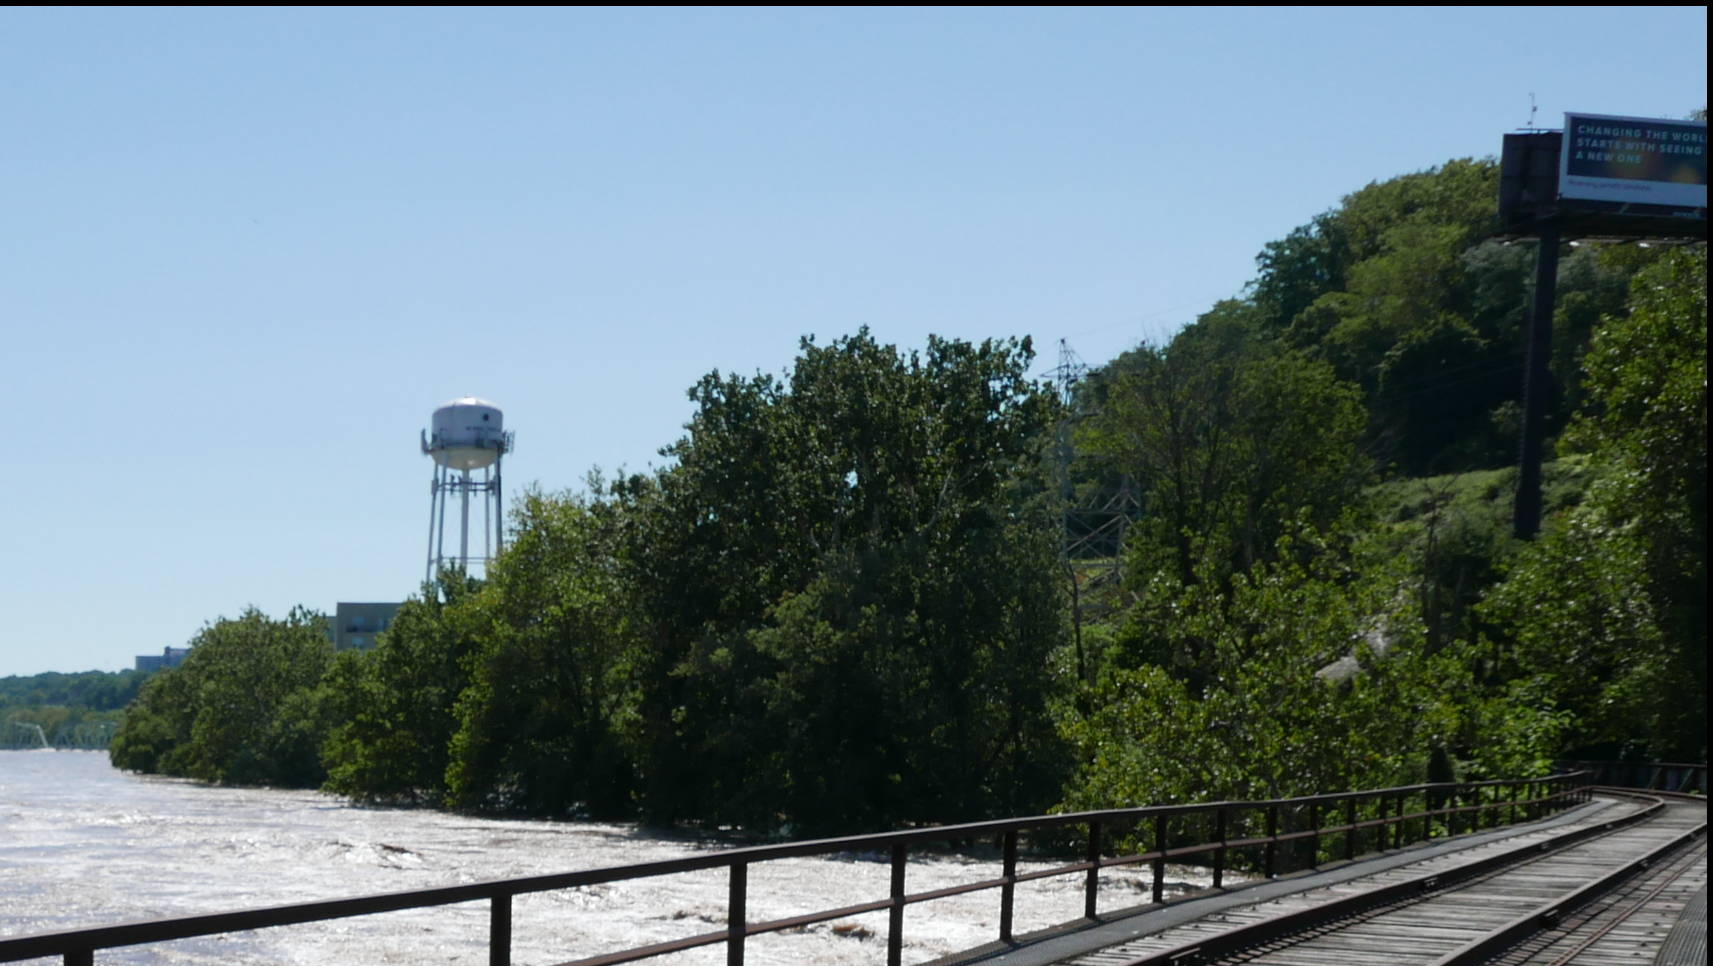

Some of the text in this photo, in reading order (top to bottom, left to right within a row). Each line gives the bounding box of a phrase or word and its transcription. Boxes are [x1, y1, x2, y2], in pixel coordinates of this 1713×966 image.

[1578, 125, 1707, 143] CHANGING THE WORL
[1576, 137, 1702, 155] STARTS WITH SEEING
[1576, 151, 1641, 164] A NEW ONE
